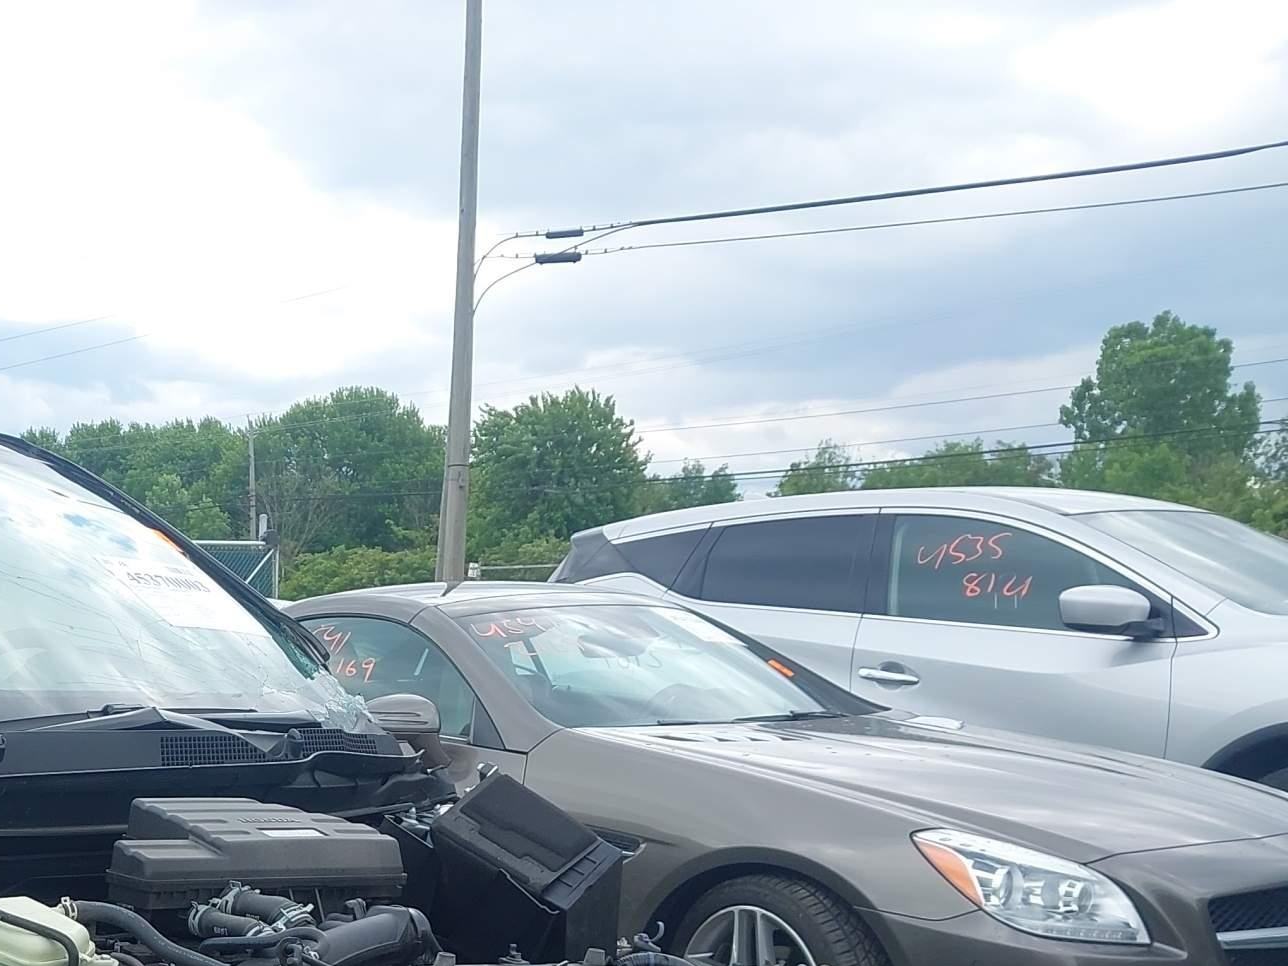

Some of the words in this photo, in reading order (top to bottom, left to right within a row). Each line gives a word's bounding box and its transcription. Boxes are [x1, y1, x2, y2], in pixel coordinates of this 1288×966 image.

[916, 531, 1013, 570] 4535
[962, 572, 1033, 600] 814
[336, 656, 377, 684] 169
